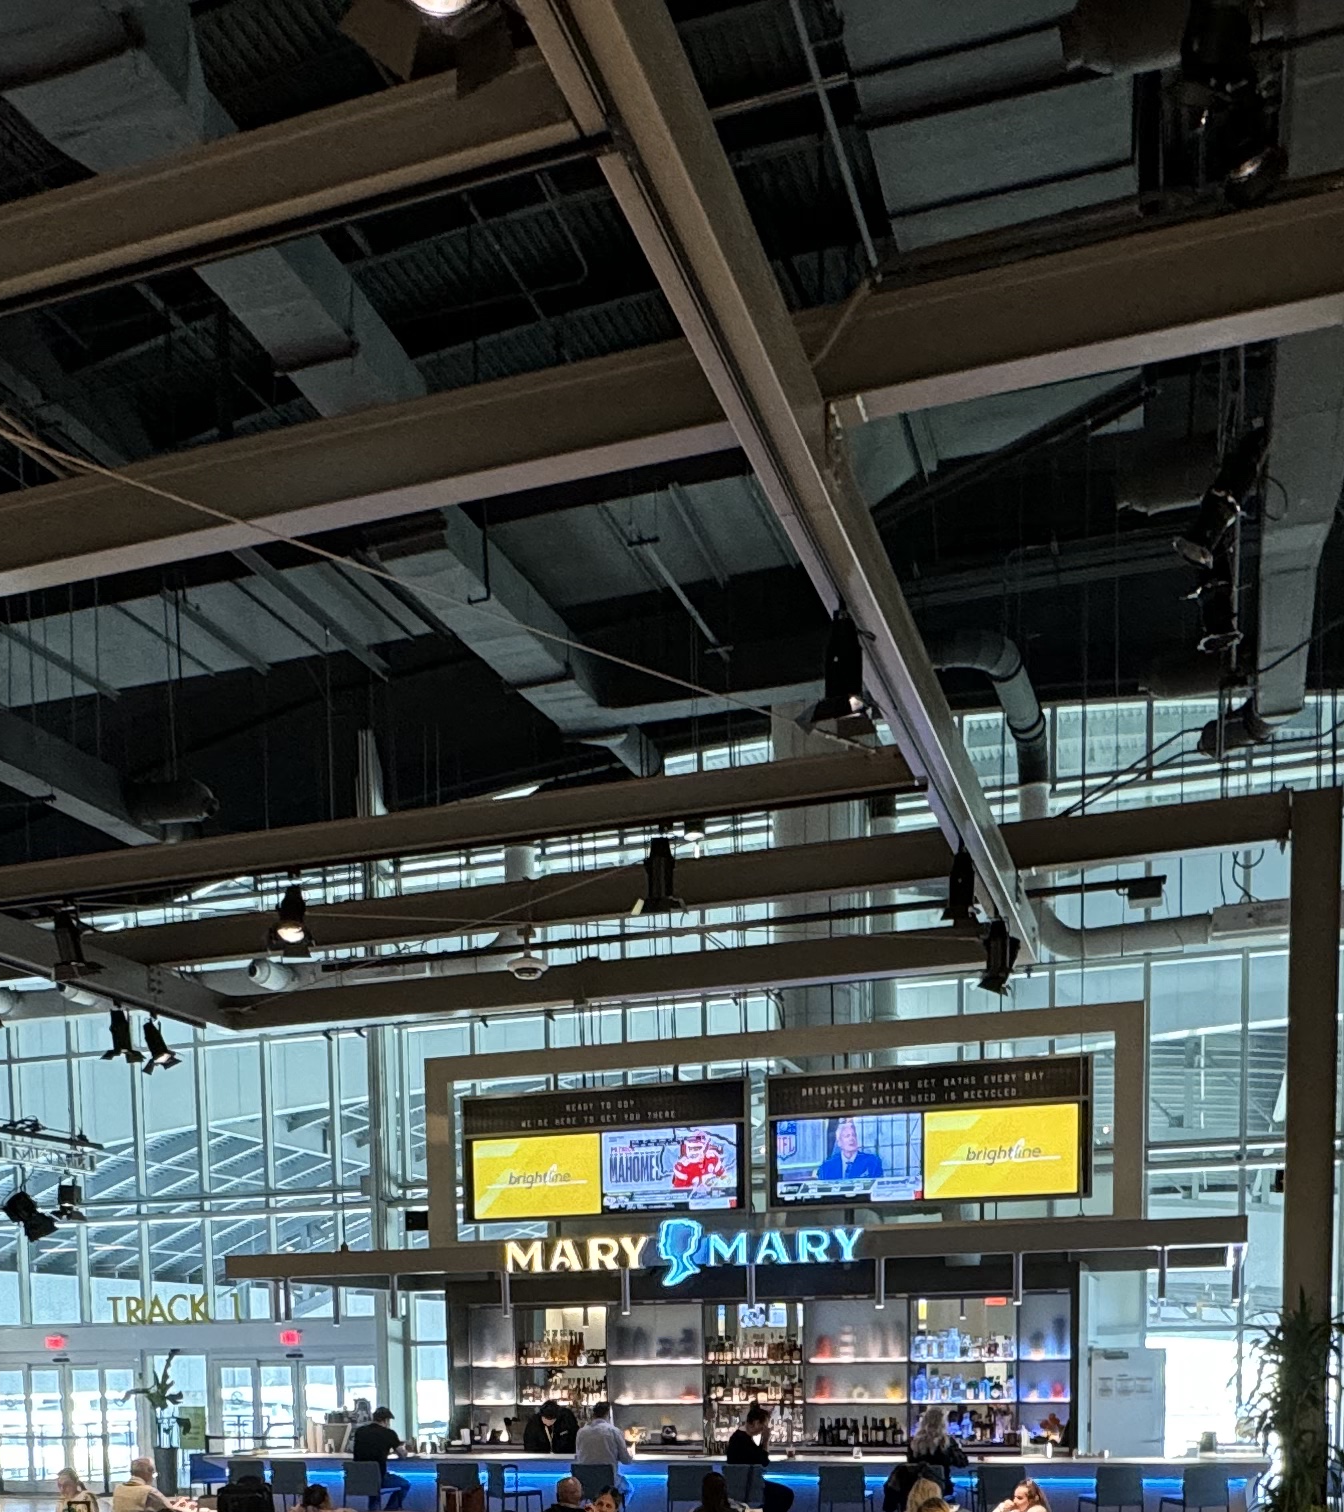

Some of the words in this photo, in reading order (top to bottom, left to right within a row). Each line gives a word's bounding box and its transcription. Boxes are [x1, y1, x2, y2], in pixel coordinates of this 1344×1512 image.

[801, 1083, 864, 1097] BRIGHTLINE
[872, 1080, 910, 1091] TRAINS
[917, 1078, 936, 1089] GET
[983, 1073, 1017, 1084] EVERY
[1024, 1070, 1045, 1082] DAY
[565, 1102, 594, 1112] READY
[600, 1100, 612, 1110] TO
[852, 1097, 864, 1107] OF
[872, 1095, 903, 1106] WATER
[910, 1092, 936, 1103] USED
[944, 1090, 956, 1101] IS
[554, 1116, 577, 1126] HERE
[583, 1115, 595, 1124] TO
[600, 1113, 617, 1123] GET
[624, 1112, 641, 1121] YOU
[966, 1142, 1042, 1166] brightline
[508, 1168, 572, 1189] brightline
[505, 1235, 649, 1274] MARY
[708, 1227, 865, 1267] MARY
[106, 1292, 214, 1326] TRACK
